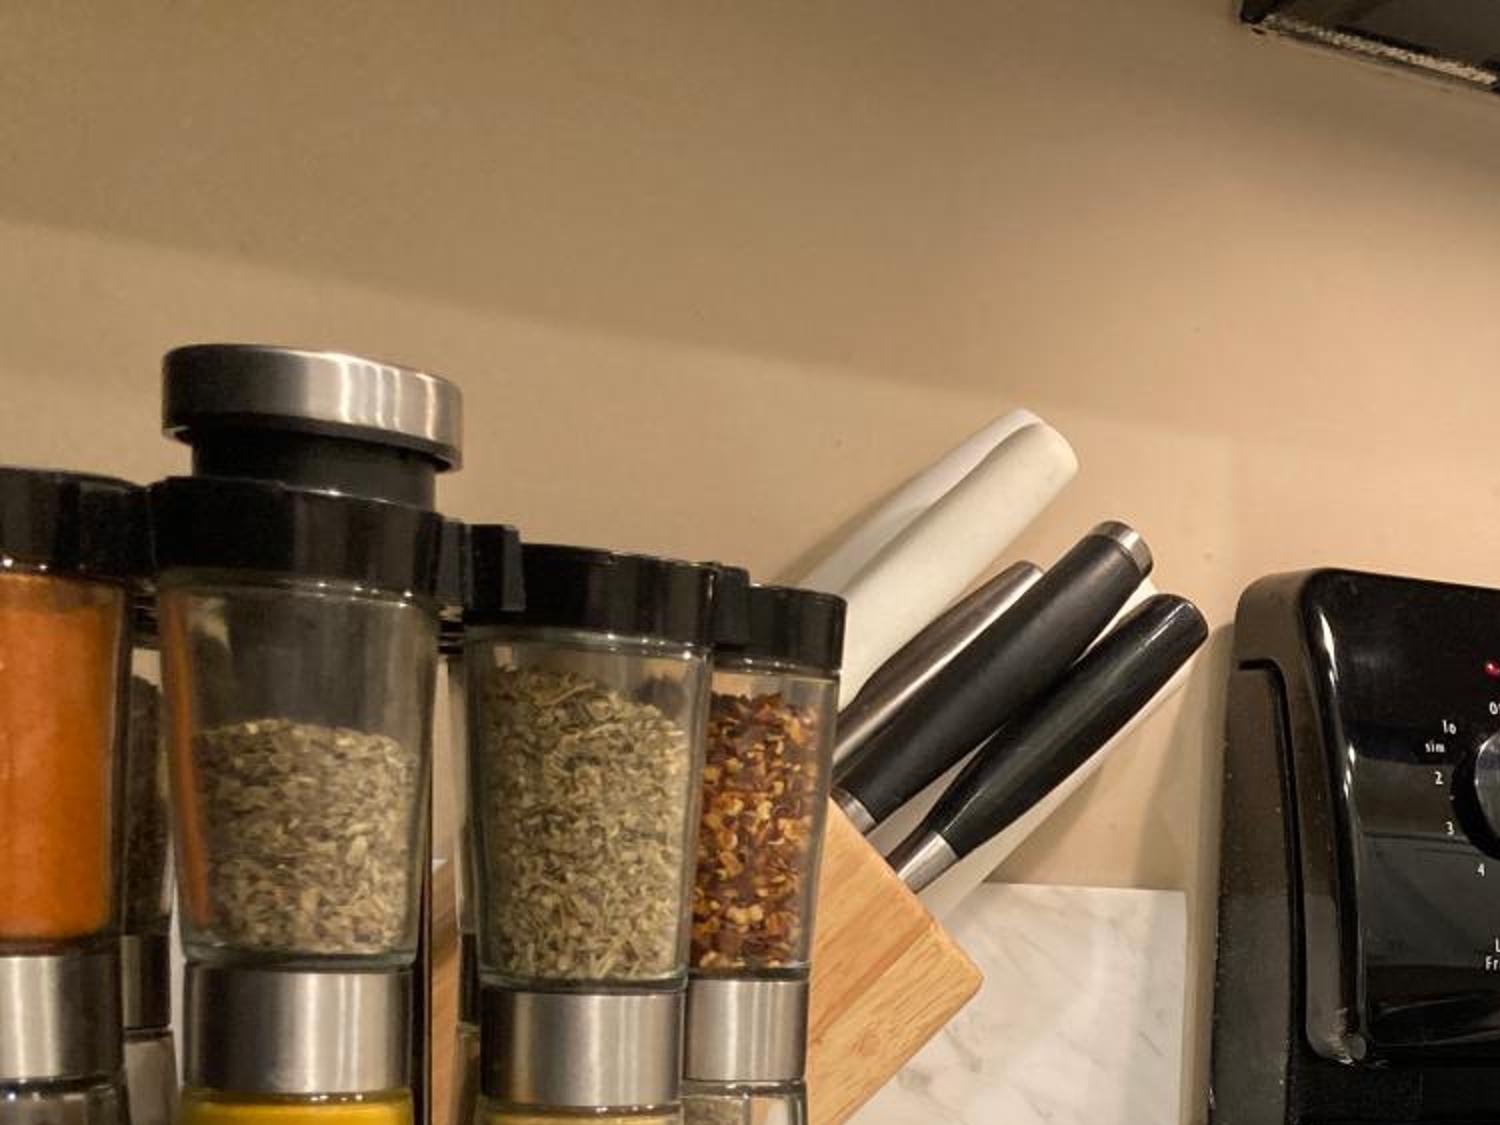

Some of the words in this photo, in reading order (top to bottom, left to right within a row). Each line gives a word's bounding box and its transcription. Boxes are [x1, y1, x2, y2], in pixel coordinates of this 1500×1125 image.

[1425, 740, 1446, 753] sim
[1434, 771, 1444, 785] 2
[1446, 821, 1455, 836] 3
[1477, 863, 1485, 877] 4
